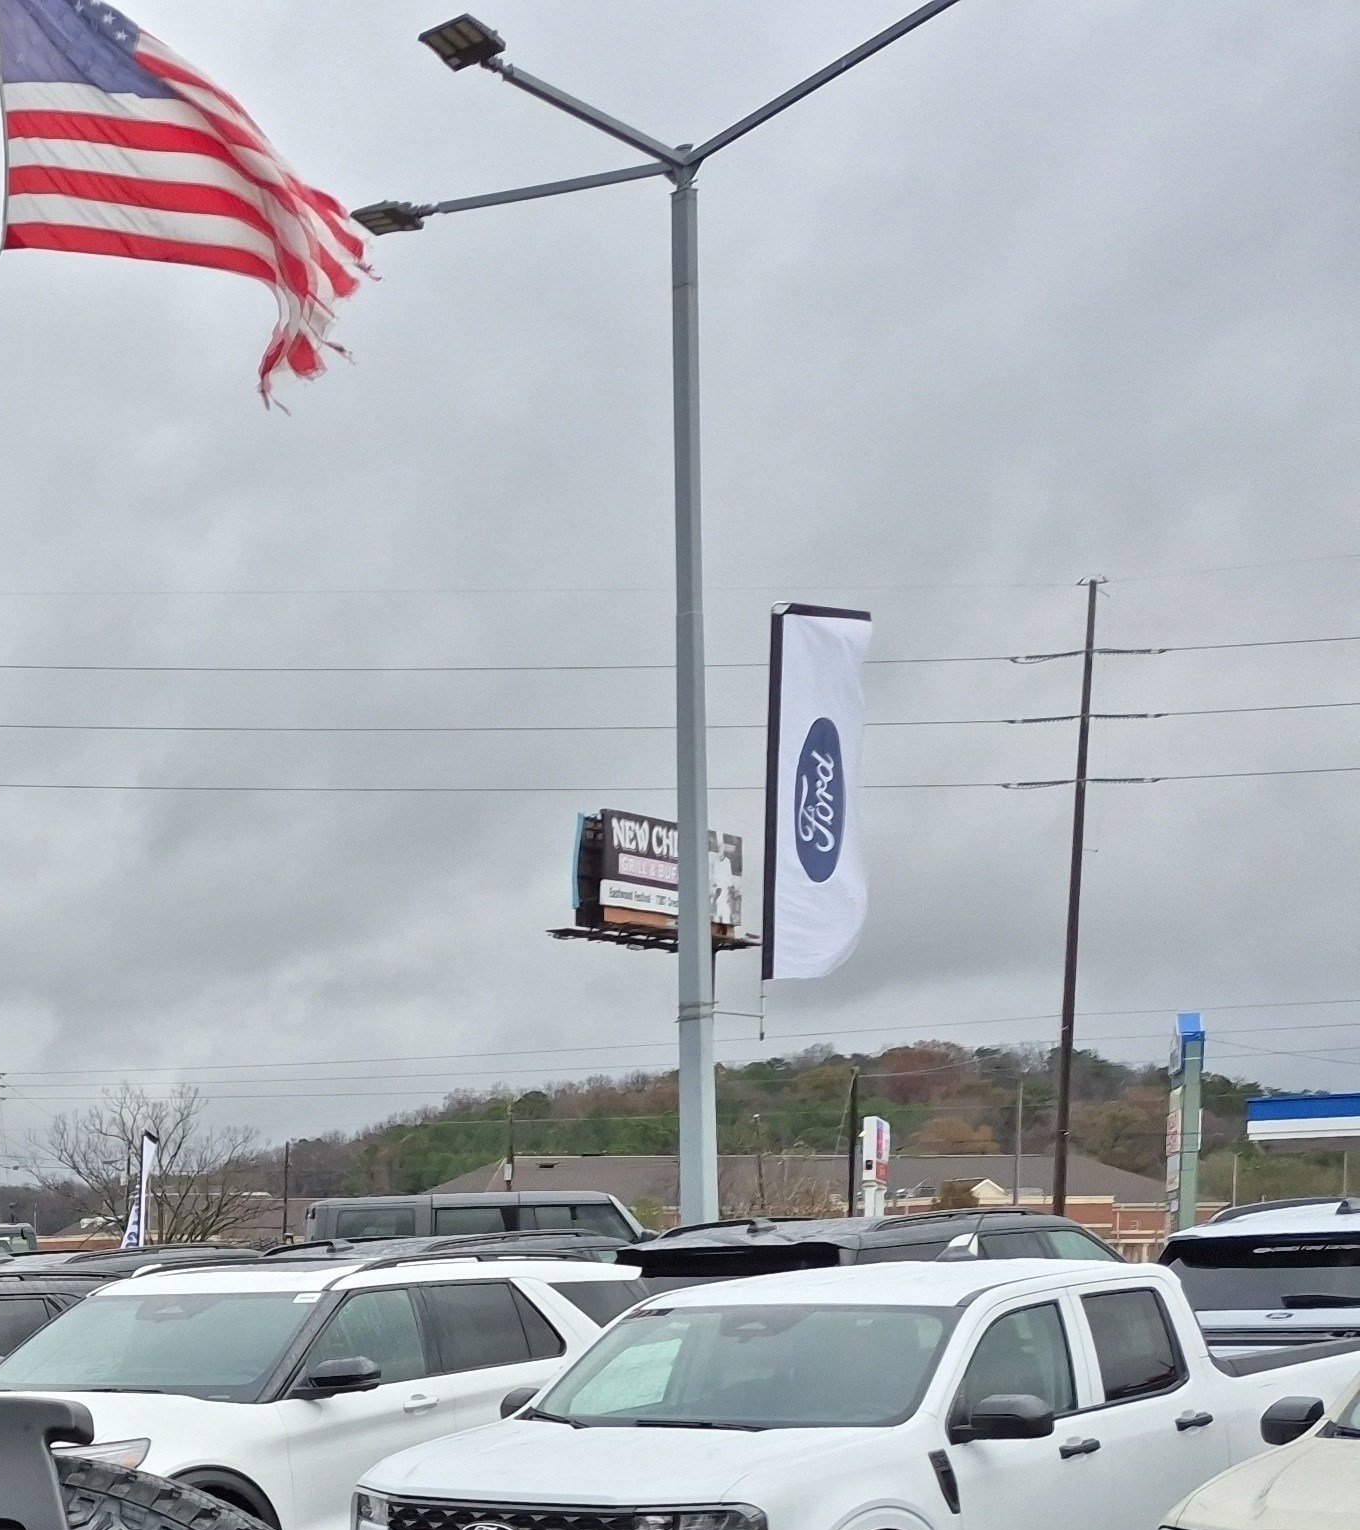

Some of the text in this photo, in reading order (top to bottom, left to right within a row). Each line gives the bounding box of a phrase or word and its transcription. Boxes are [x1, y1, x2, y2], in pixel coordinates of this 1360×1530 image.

[798, 750, 835, 852] Ford
[611, 817, 678, 858] NEW CHI
[658, 864, 678, 881] BUF
